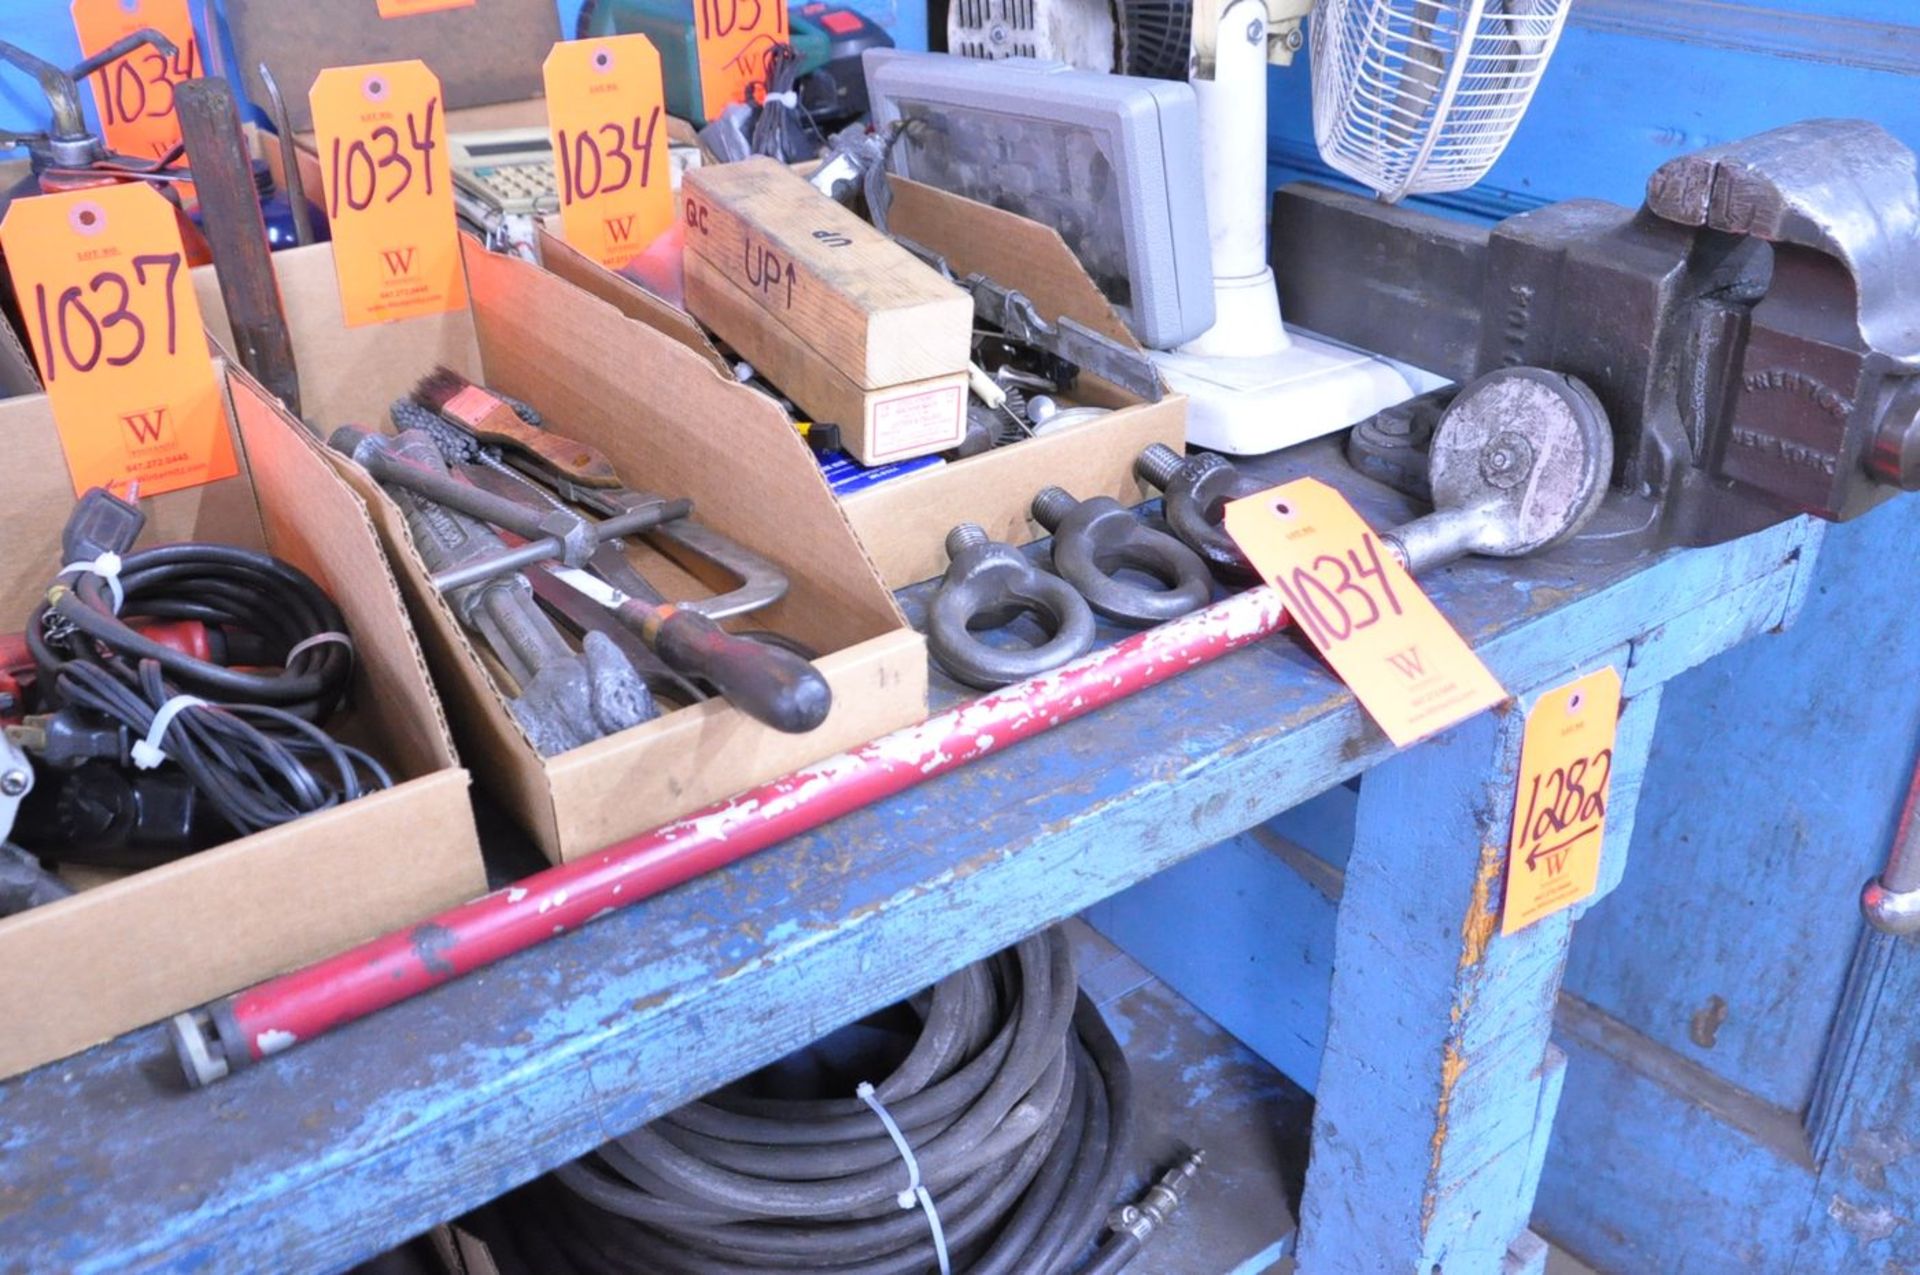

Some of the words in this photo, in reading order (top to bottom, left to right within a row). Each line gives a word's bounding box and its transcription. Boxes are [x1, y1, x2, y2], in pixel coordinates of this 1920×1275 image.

[332, 97, 437, 219] 1034
[559, 106, 660, 206] 1034
[604, 215, 637, 243] W
[686, 199, 709, 235] QC
[381, 247, 416, 276] W
[745, 238, 782, 293] UP
[36, 253, 181, 382] 1037
[122, 408, 166, 445] W
[1275, 533, 1402, 651] 1034
[1386, 646, 1425, 680] W
[1519, 748, 1612, 849] 1282
